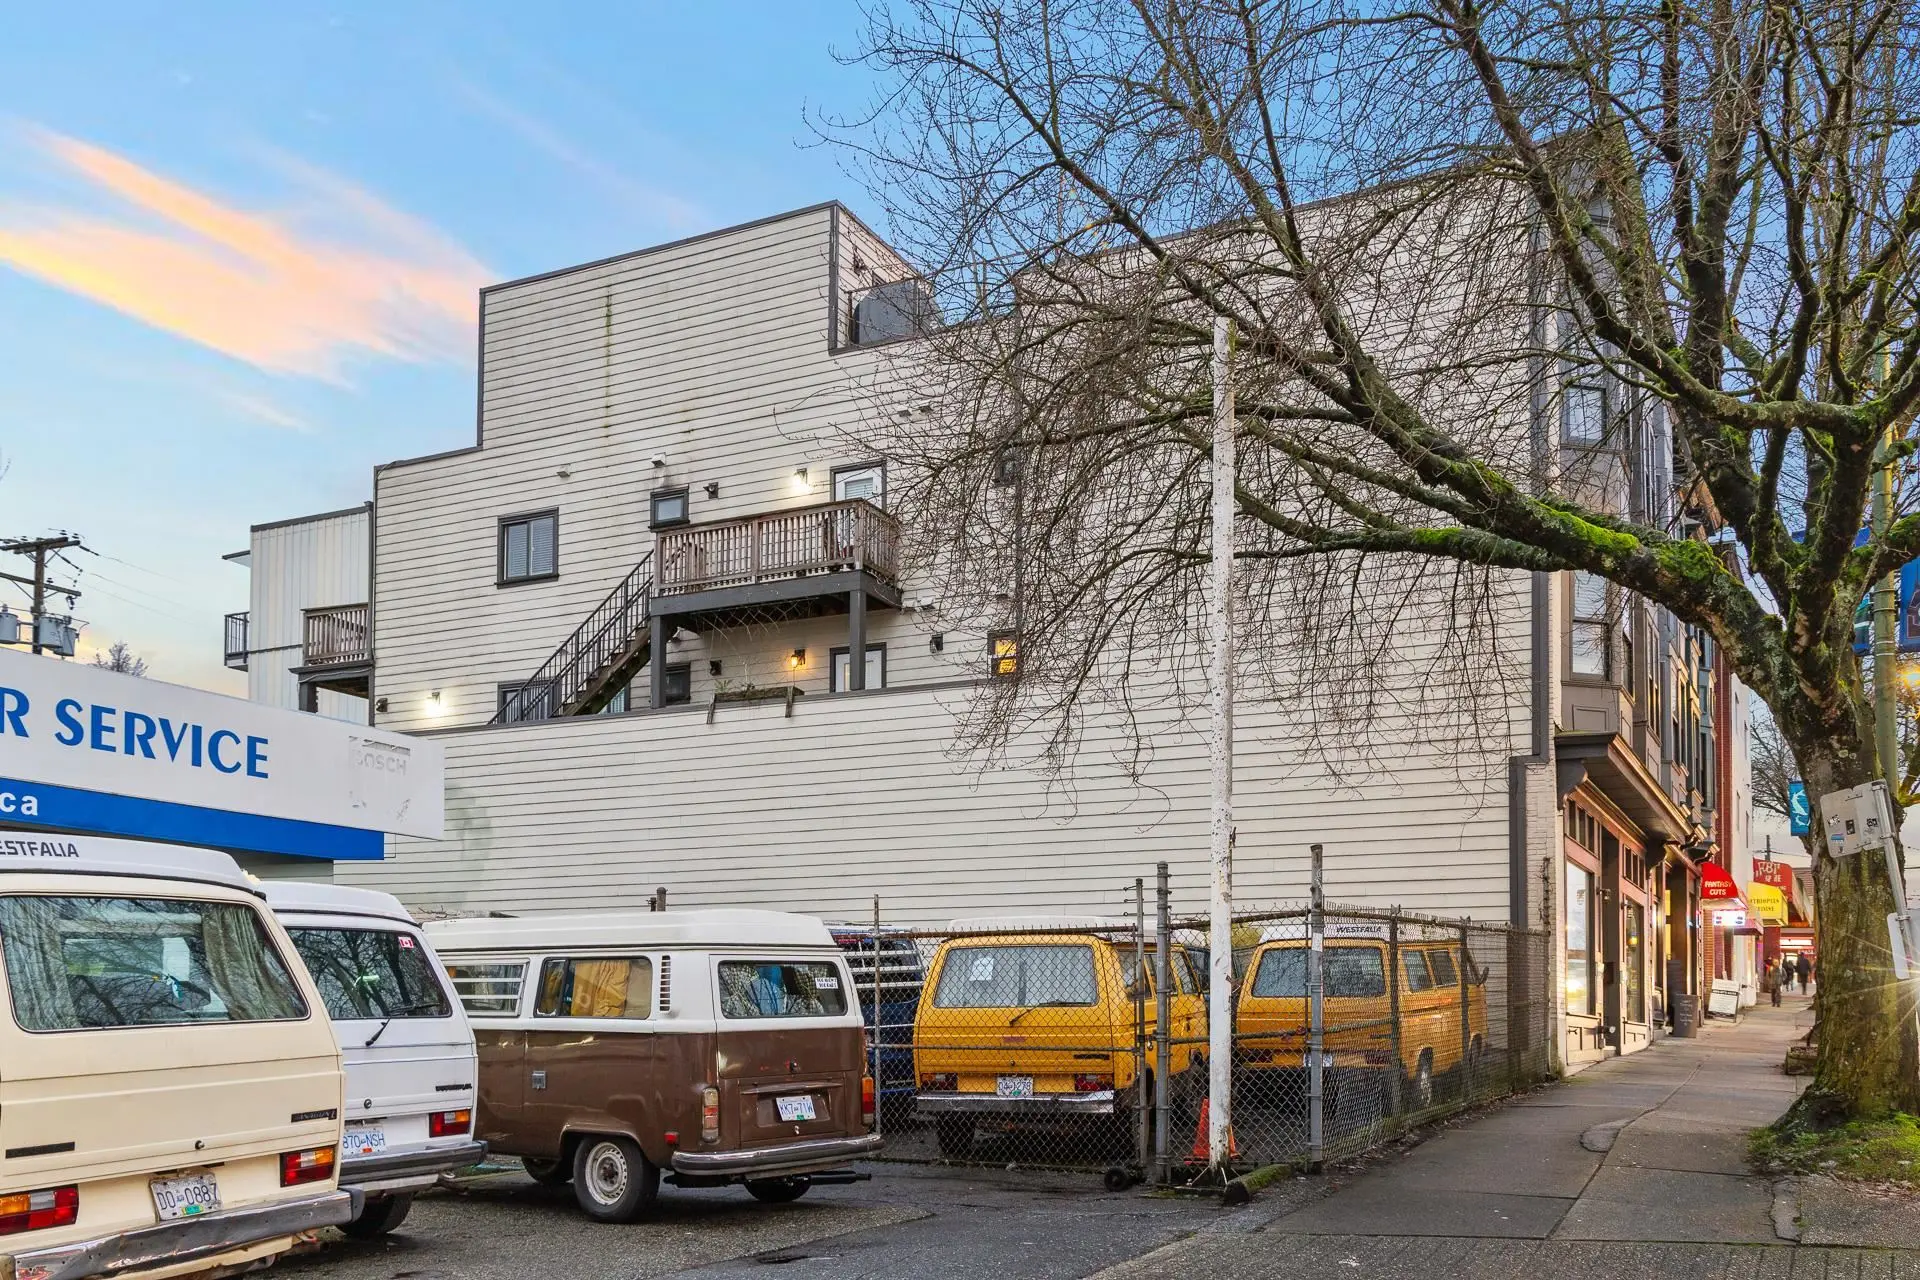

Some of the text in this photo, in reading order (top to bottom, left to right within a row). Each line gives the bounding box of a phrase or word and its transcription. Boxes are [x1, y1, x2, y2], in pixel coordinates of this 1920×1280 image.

[54, 698, 270, 779] SERVICE
[355, 750, 407, 776] OSCH
[0, 792, 39, 816] ca
[1704, 880, 1733, 888] FANTASY
[1709, 888, 1727, 896] CUTS
[1336, 925, 1382, 933] WESTFALIA
[365, 1132, 386, 1147] NSH
[184, 1183, 218, 1205] 0887
